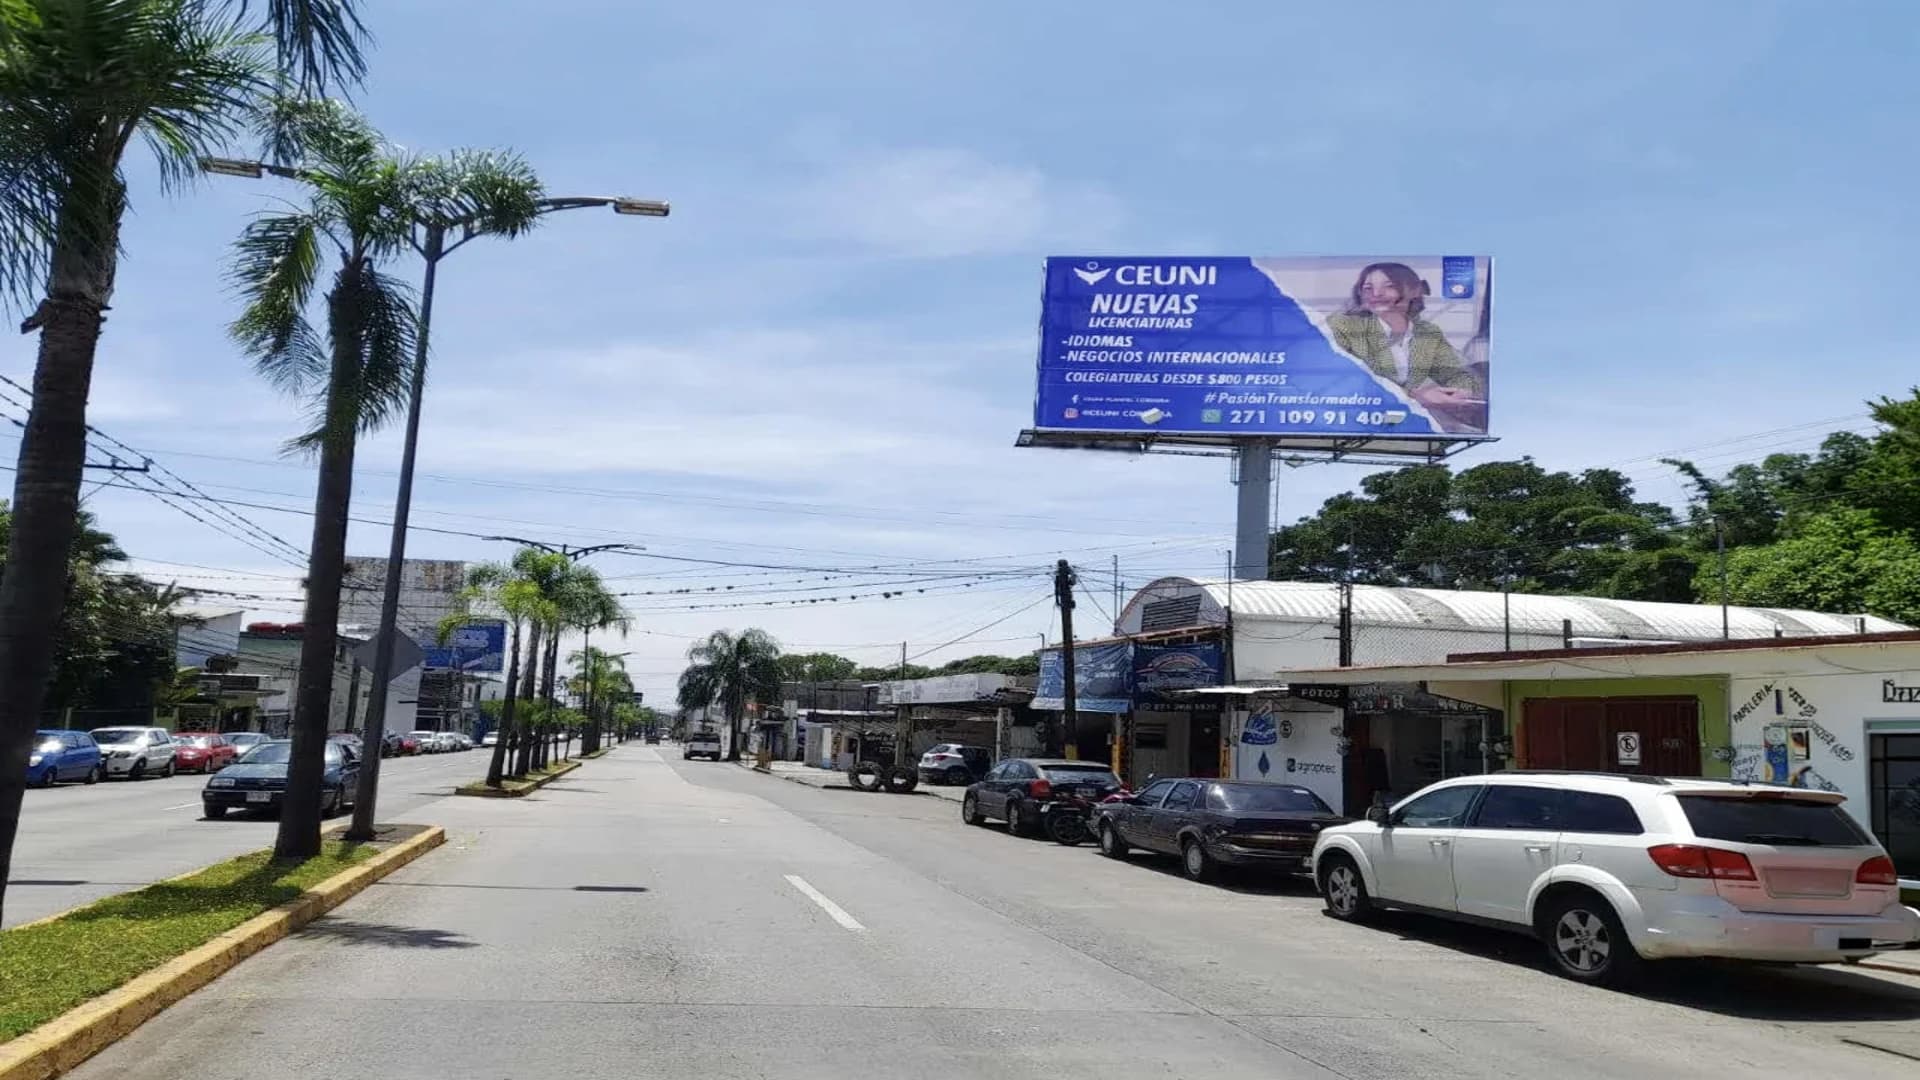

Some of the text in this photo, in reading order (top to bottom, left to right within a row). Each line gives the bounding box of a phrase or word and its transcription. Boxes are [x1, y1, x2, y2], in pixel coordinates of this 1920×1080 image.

[1115, 265, 1217, 285] CEUNI
[1090, 293, 1200, 314] NUEVAS
[1088, 316, 1194, 329] LICENCIATURAS
[1061, 335, 1134, 347] -IDIOMAS
[1060, 350, 1285, 364] -NEGOCIOS INTERNACIONALES
[1065, 371, 1288, 385] COLEGIATURAS DESDE $800 PESOS
[1204, 391, 1382, 406] #PasiónTransformadora
[1229, 410, 1384, 425] 271 109 91 40
[1301, 688, 1341, 698] FOTOS
